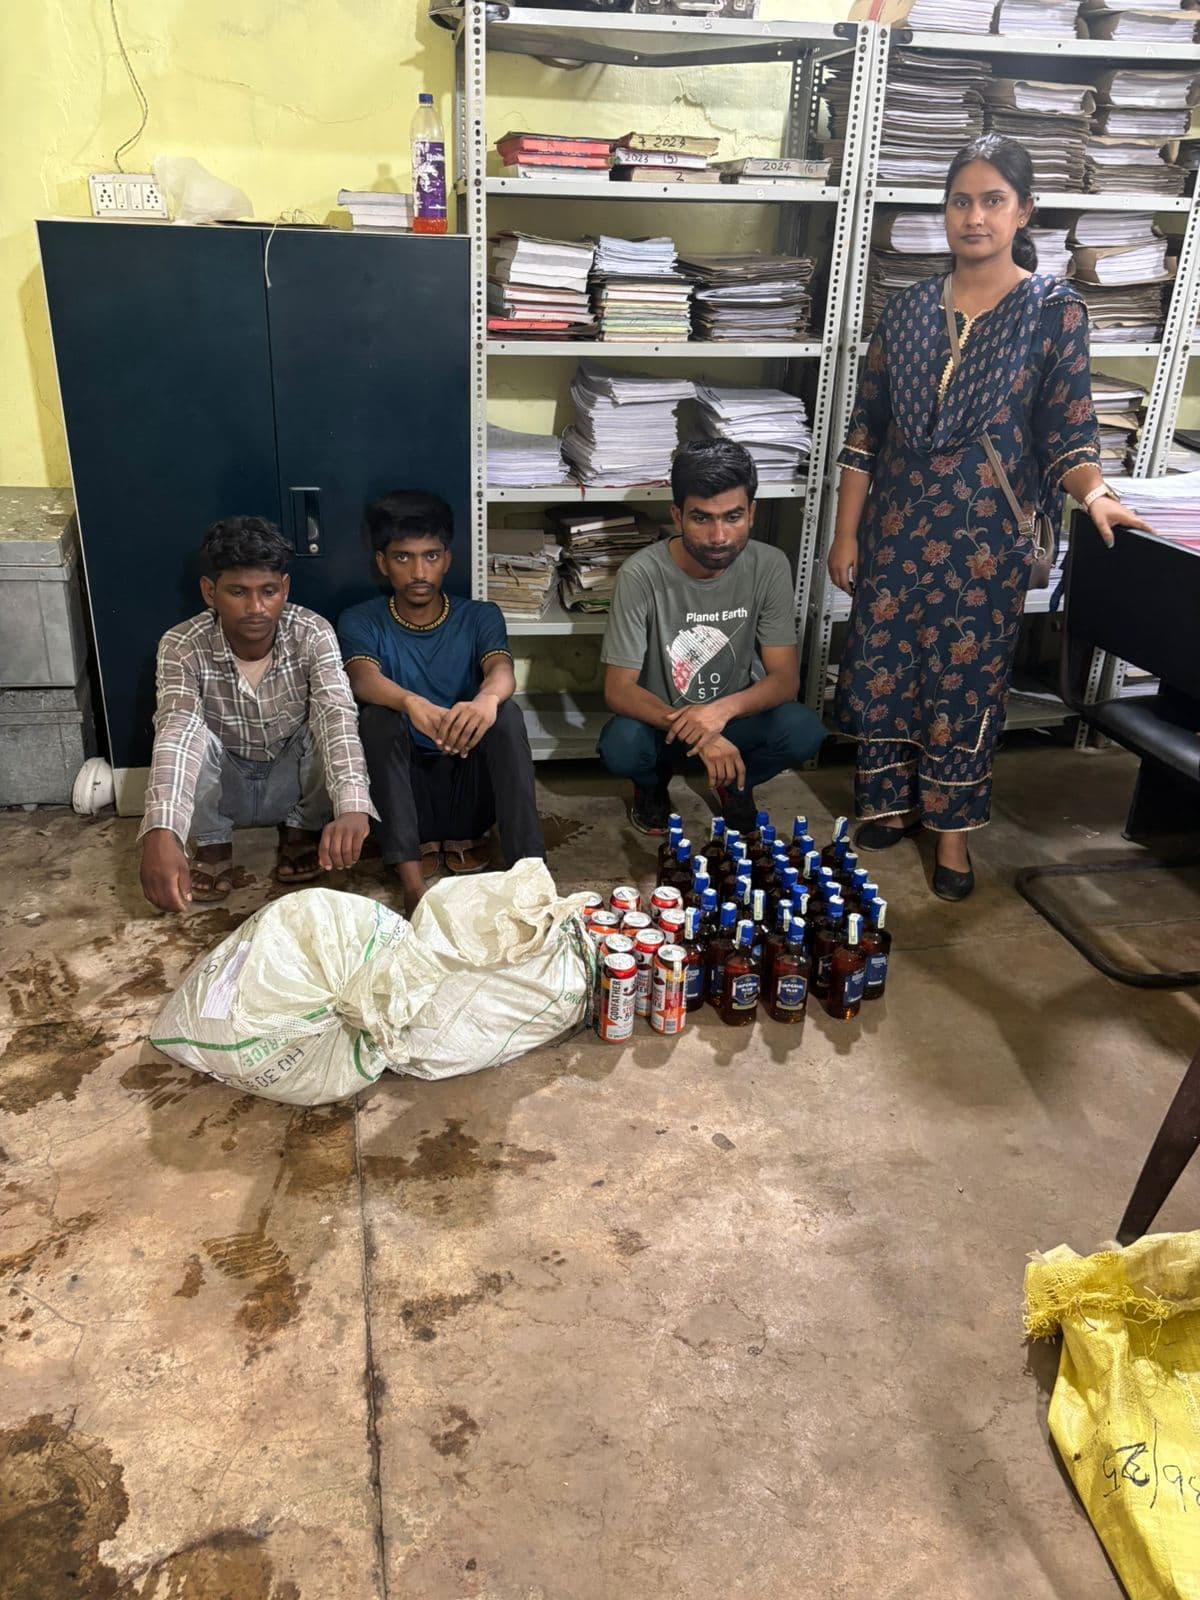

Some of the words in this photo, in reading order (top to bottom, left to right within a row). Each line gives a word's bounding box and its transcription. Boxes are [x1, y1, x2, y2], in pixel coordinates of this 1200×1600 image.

[686, 611, 719, 623] Planet
[721, 607, 748, 621] Earth
[610, 979, 621, 1021] GODFATHER
